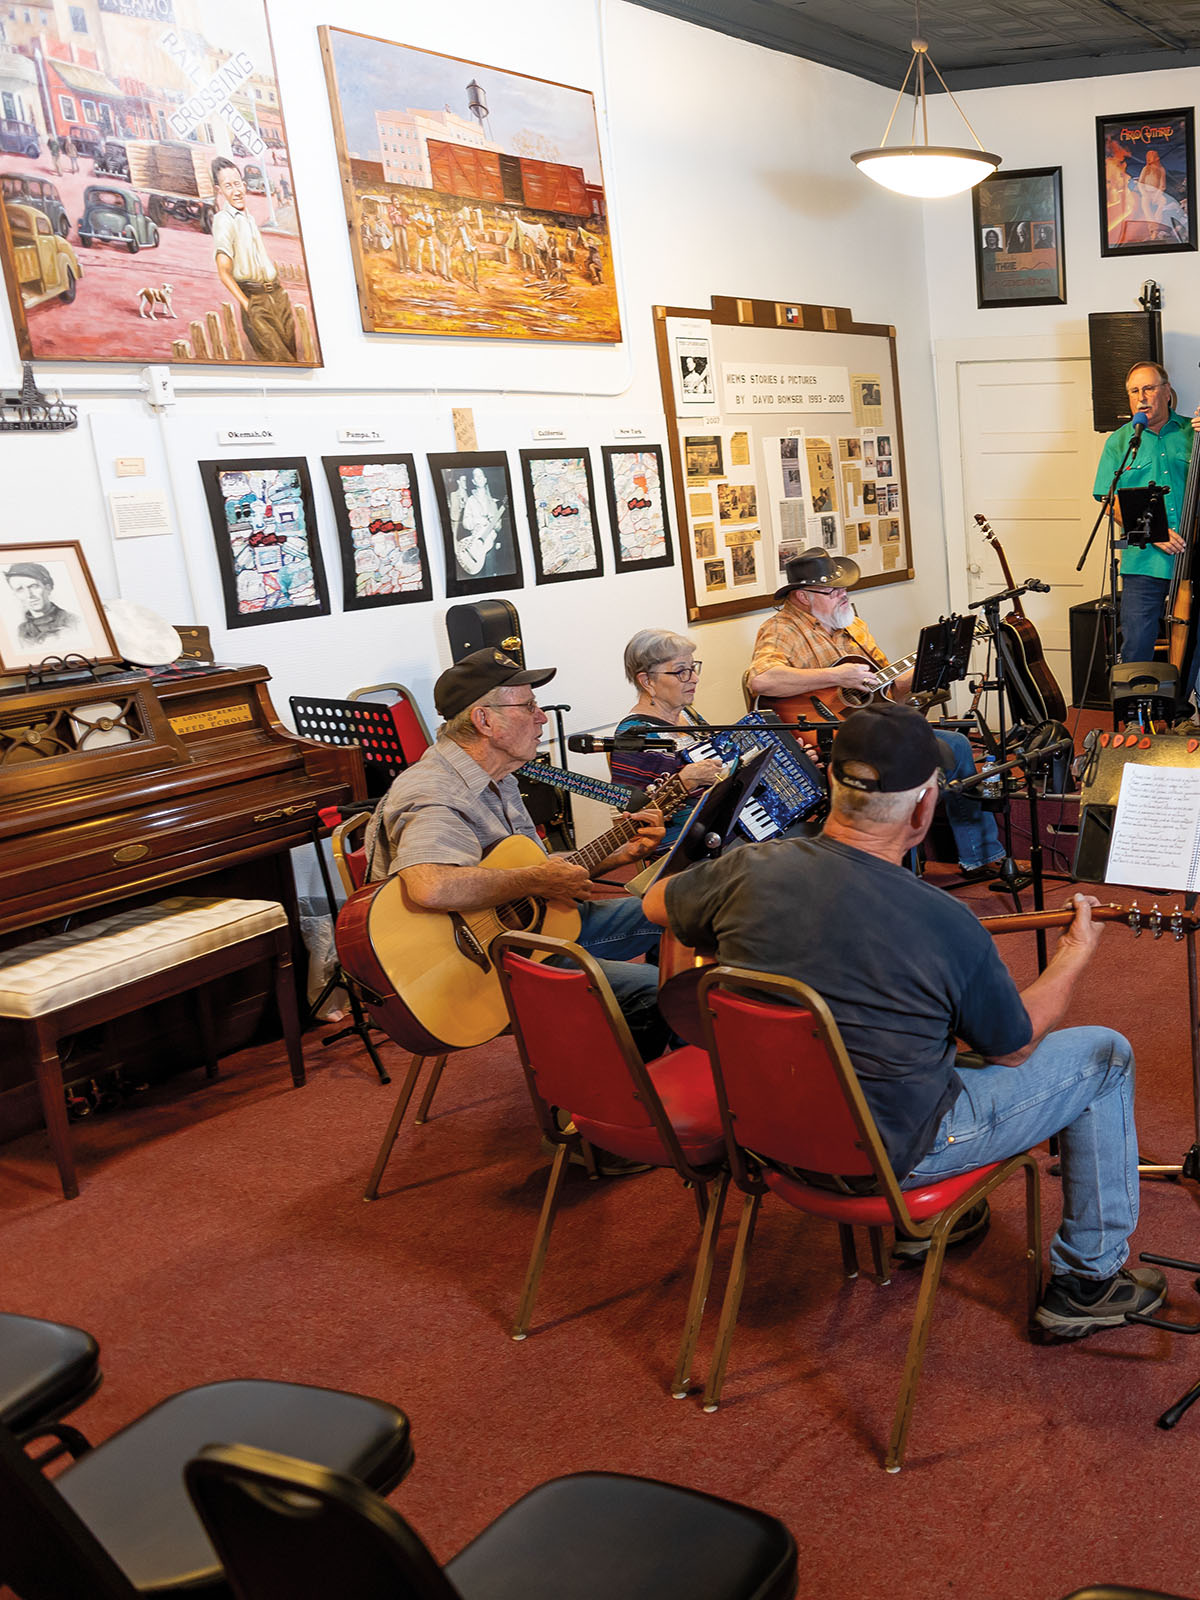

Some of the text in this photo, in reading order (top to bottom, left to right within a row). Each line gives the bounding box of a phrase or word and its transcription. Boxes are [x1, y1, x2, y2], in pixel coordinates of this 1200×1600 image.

[163, 31, 202, 88] RAIL
[170, 51, 254, 136] CROSSING
[219, 102, 265, 156] ROAD
[726, 374, 817, 385] NEWS STORIES & PICTURES
[735, 395, 745, 405] BY
[753, 395, 774, 404] DAVID
[778, 395, 804, 404] BOWSER
[183, 712, 211, 722] LOVING
[216, 705, 248, 715] MEMORY
[178, 715, 249, 734] REED ECHOLS
